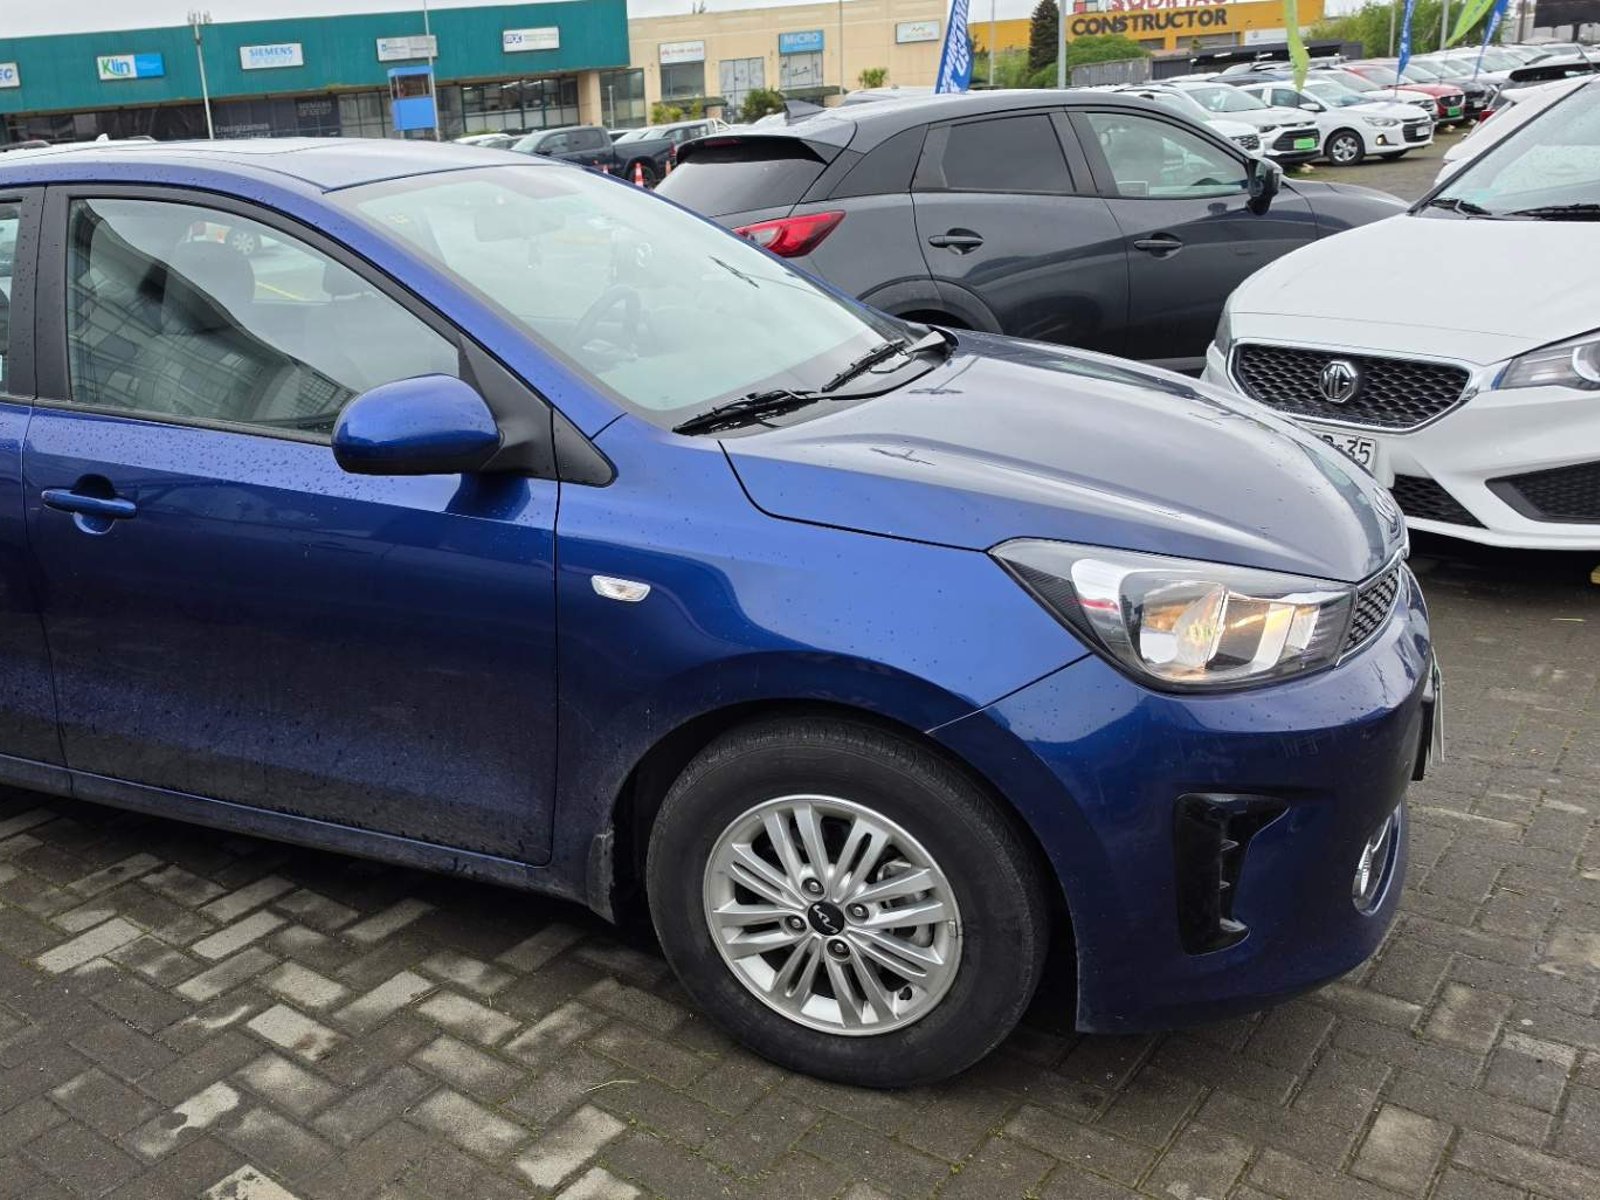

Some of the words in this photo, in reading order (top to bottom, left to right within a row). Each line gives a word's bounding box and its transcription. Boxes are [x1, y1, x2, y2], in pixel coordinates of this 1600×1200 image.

[1071, 8, 1228, 36] CONSTRUCTOR
[249, 47, 294, 58] SIEMENS
[101, 58, 131, 76] Klin
